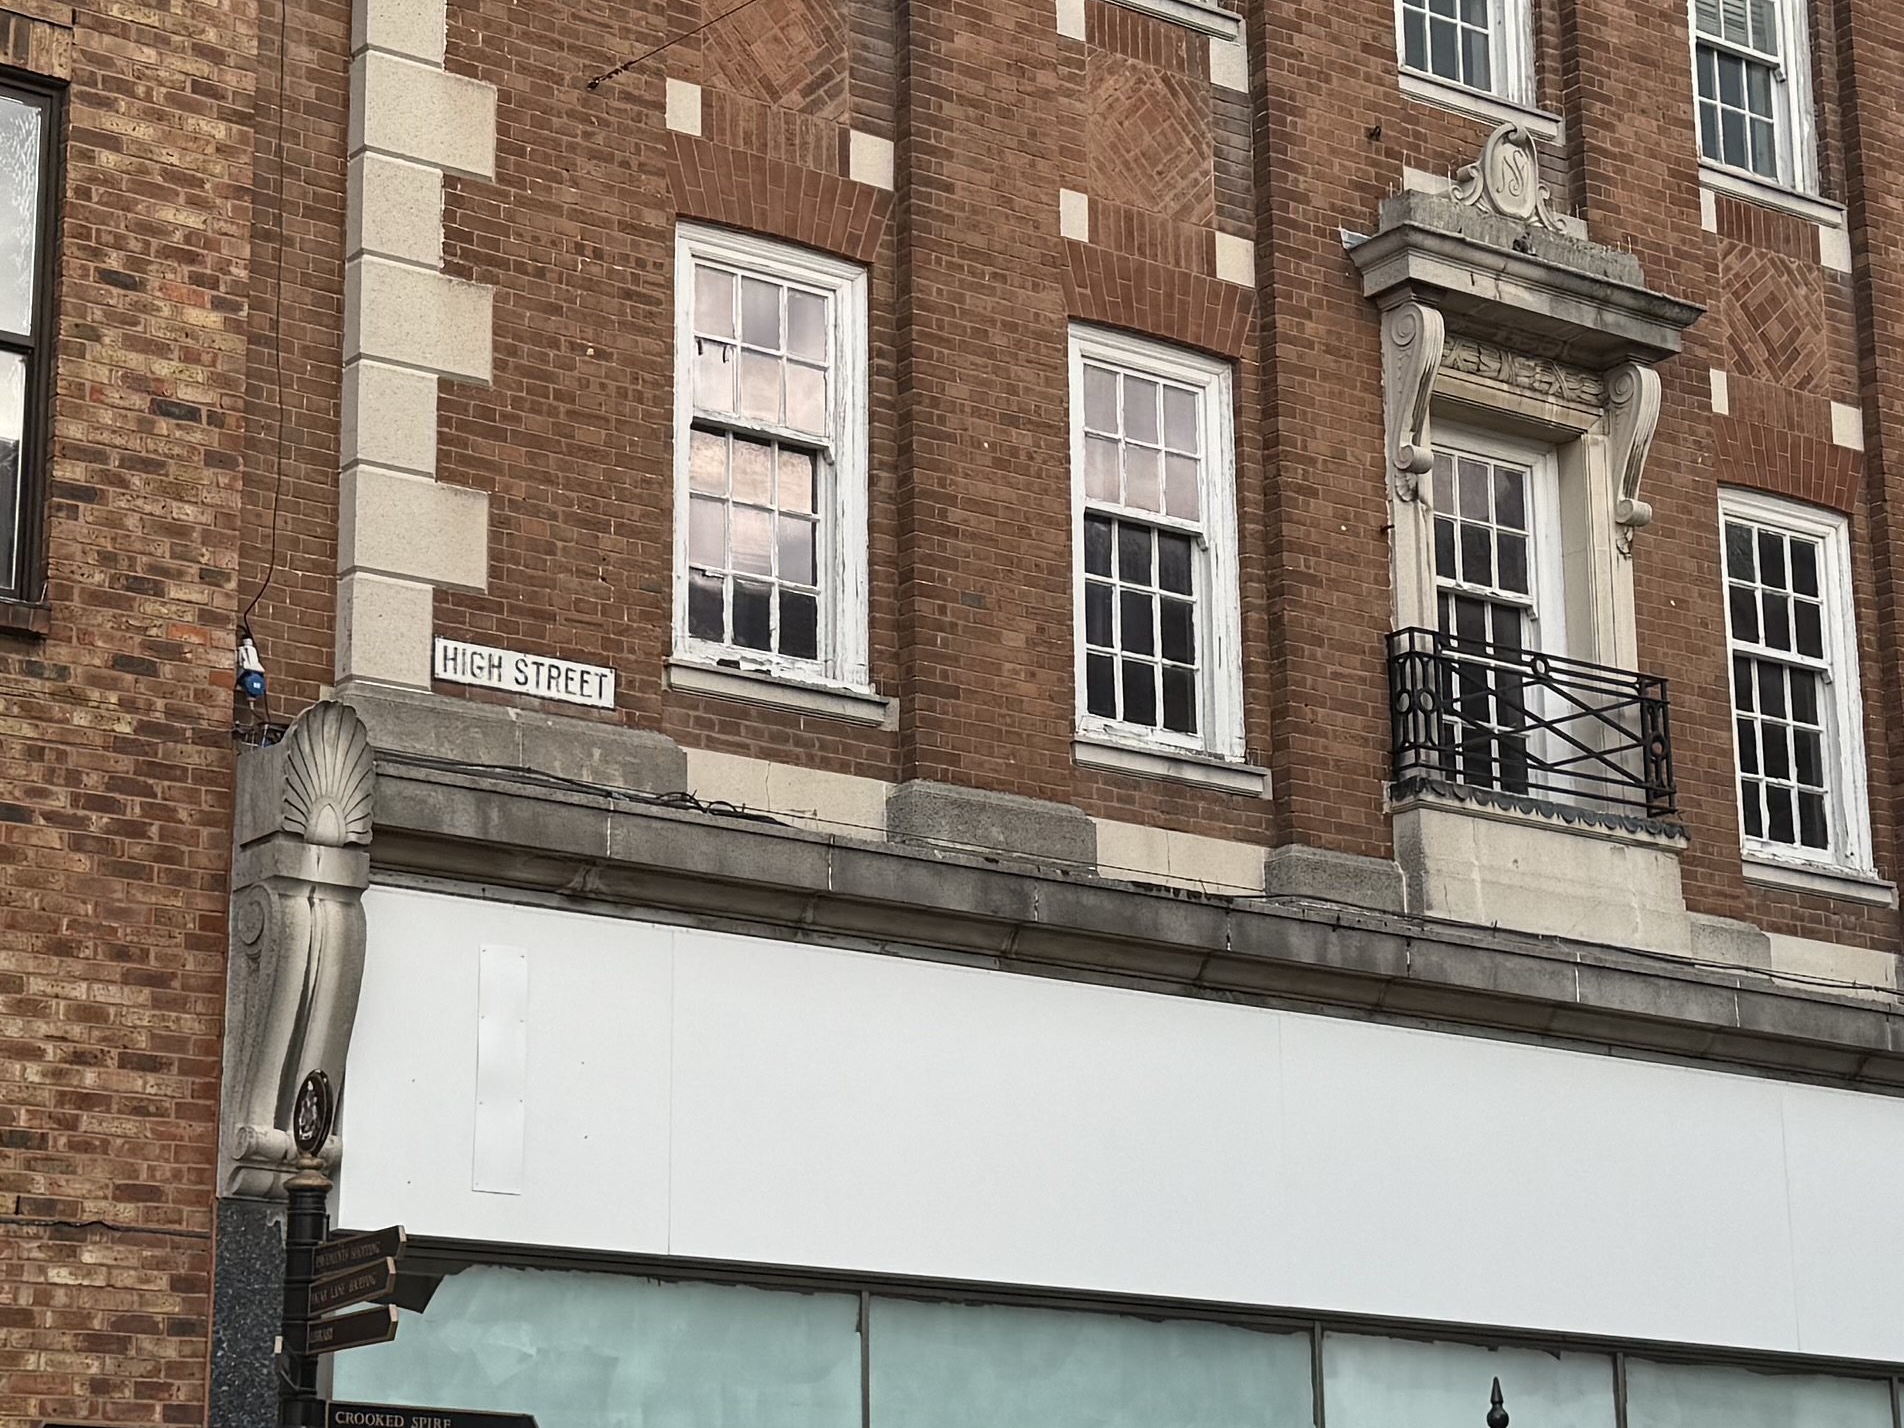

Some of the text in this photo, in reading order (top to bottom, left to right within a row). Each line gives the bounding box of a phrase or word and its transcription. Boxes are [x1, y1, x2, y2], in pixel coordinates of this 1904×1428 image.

[443, 645, 608, 700] HIGH STREET
[335, 1411, 404, 1428] CROOKED
